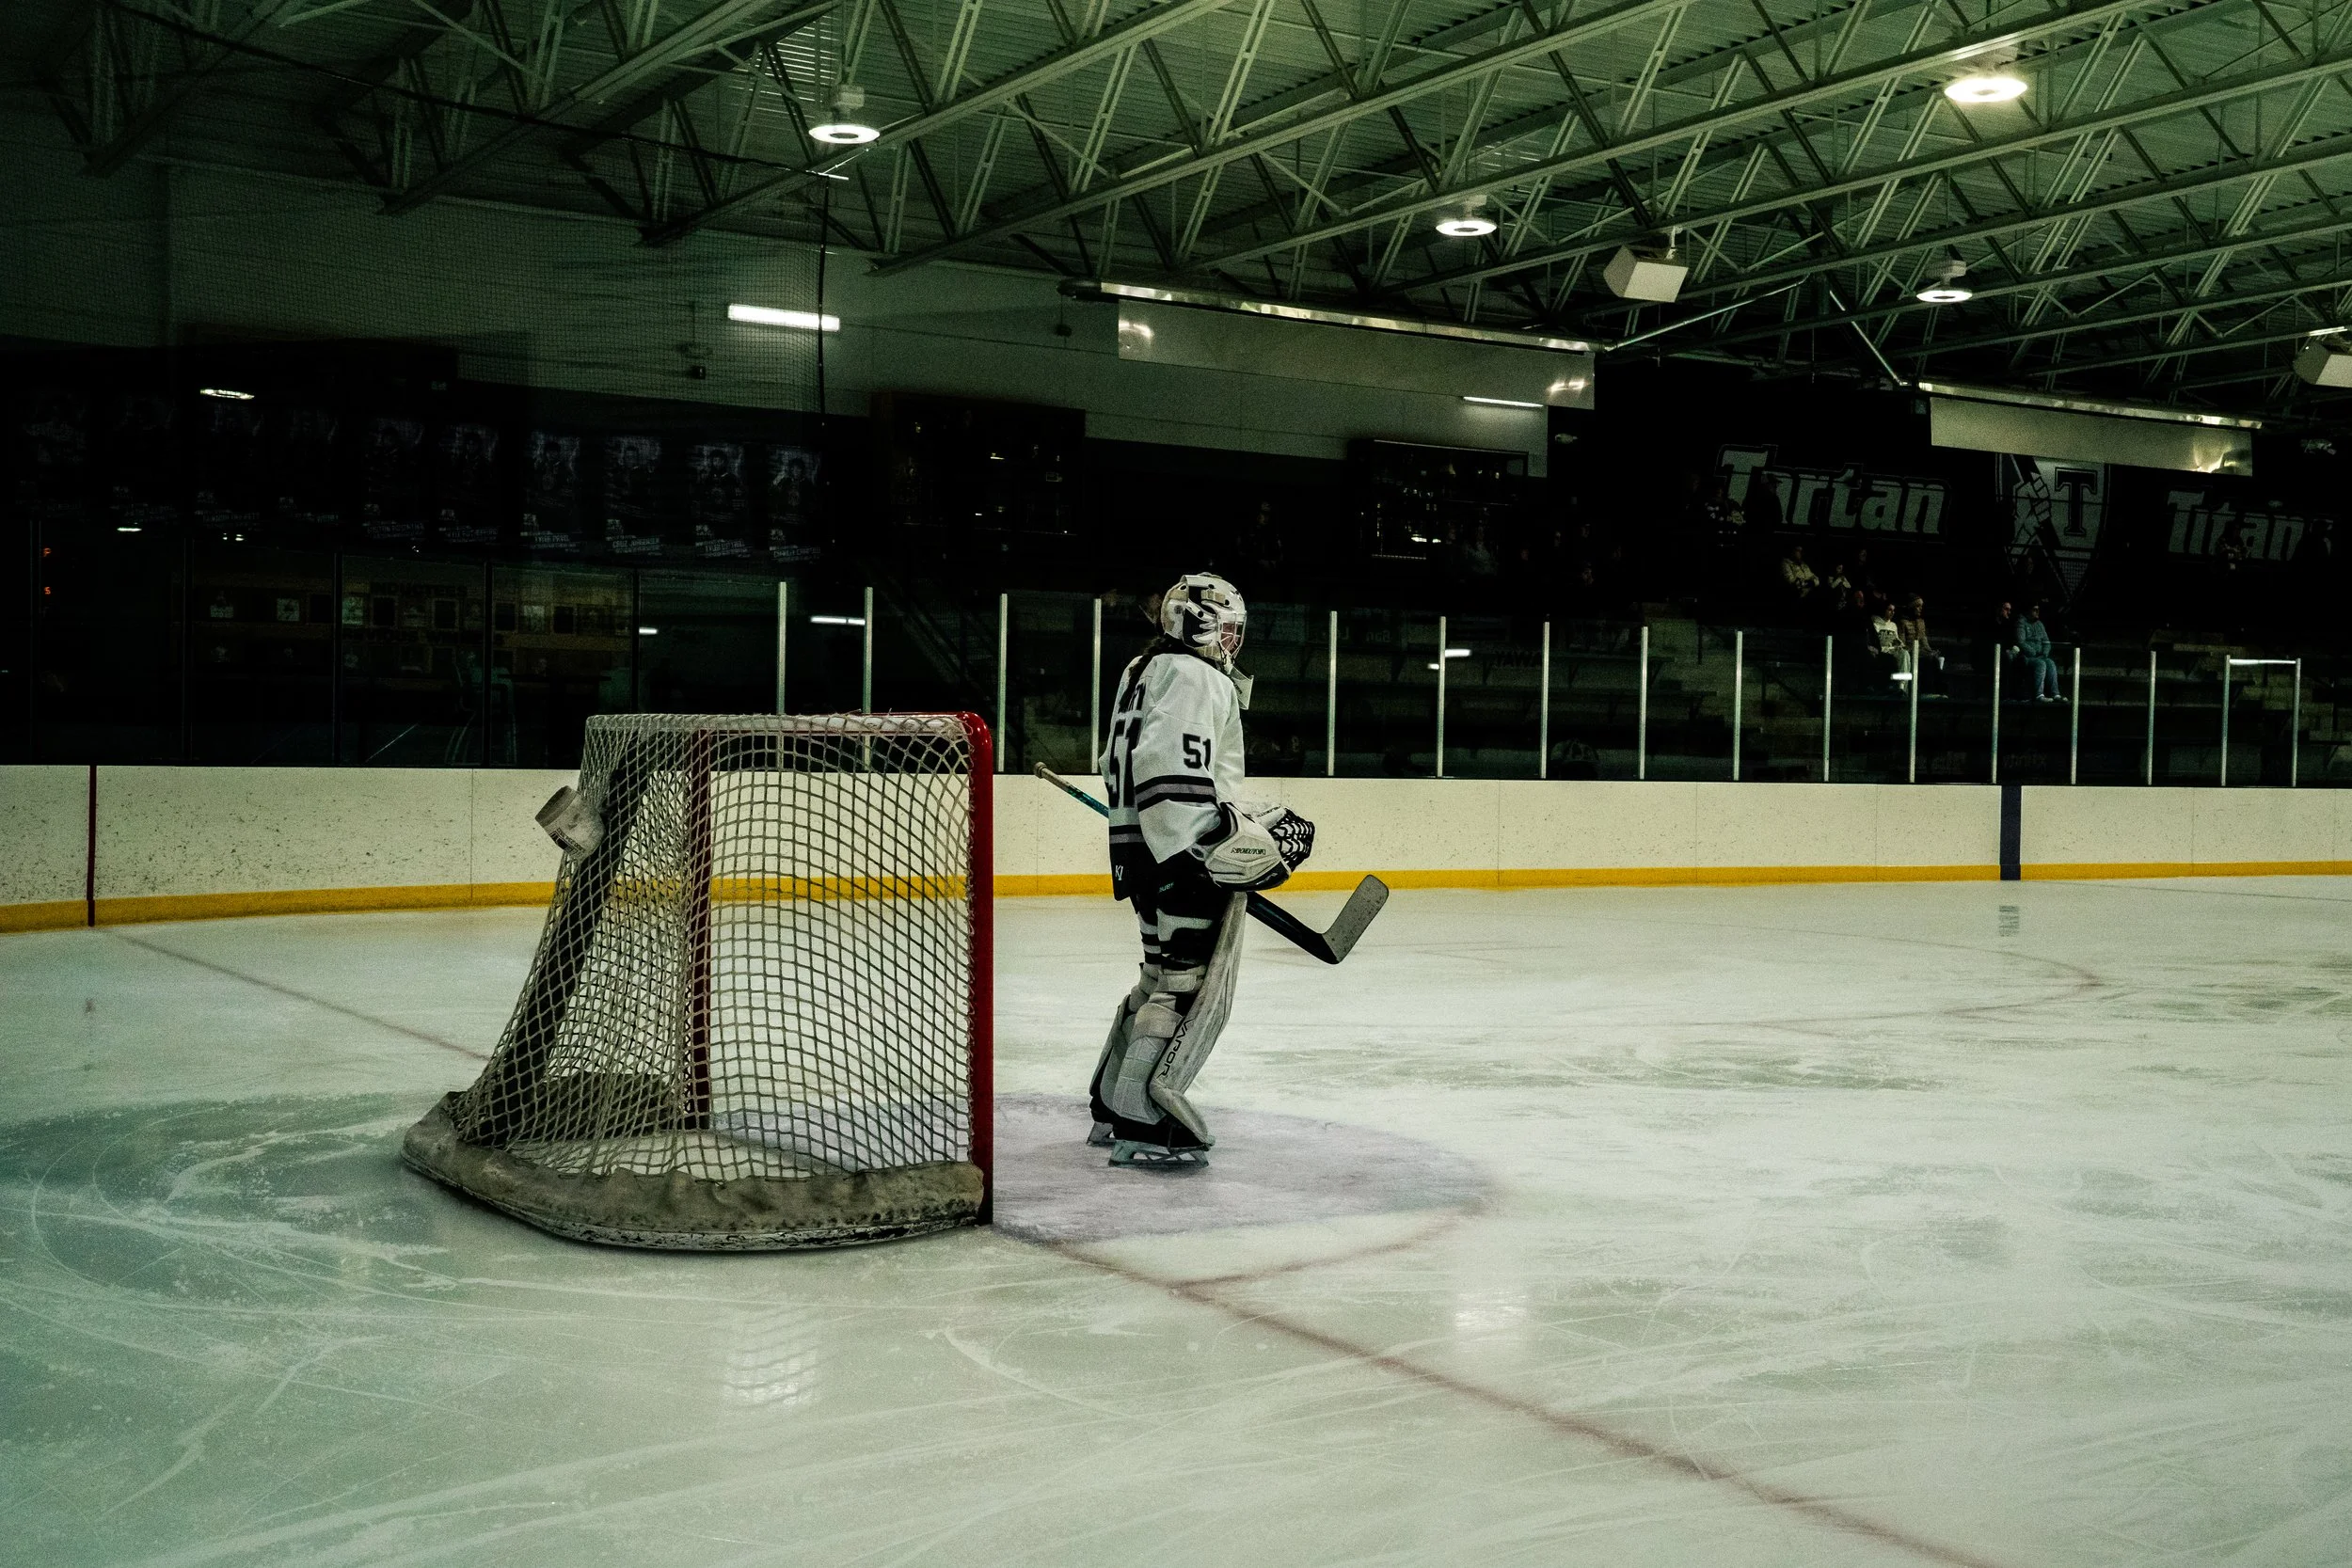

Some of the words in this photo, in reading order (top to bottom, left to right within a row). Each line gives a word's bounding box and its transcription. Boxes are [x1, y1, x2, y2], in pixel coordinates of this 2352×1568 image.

[342, 627, 417, 642] REVIOUS
[1108, 718, 1142, 810] 51
[1183, 733, 1212, 772] 51
[1156, 1018, 1196, 1080] VAPOR
